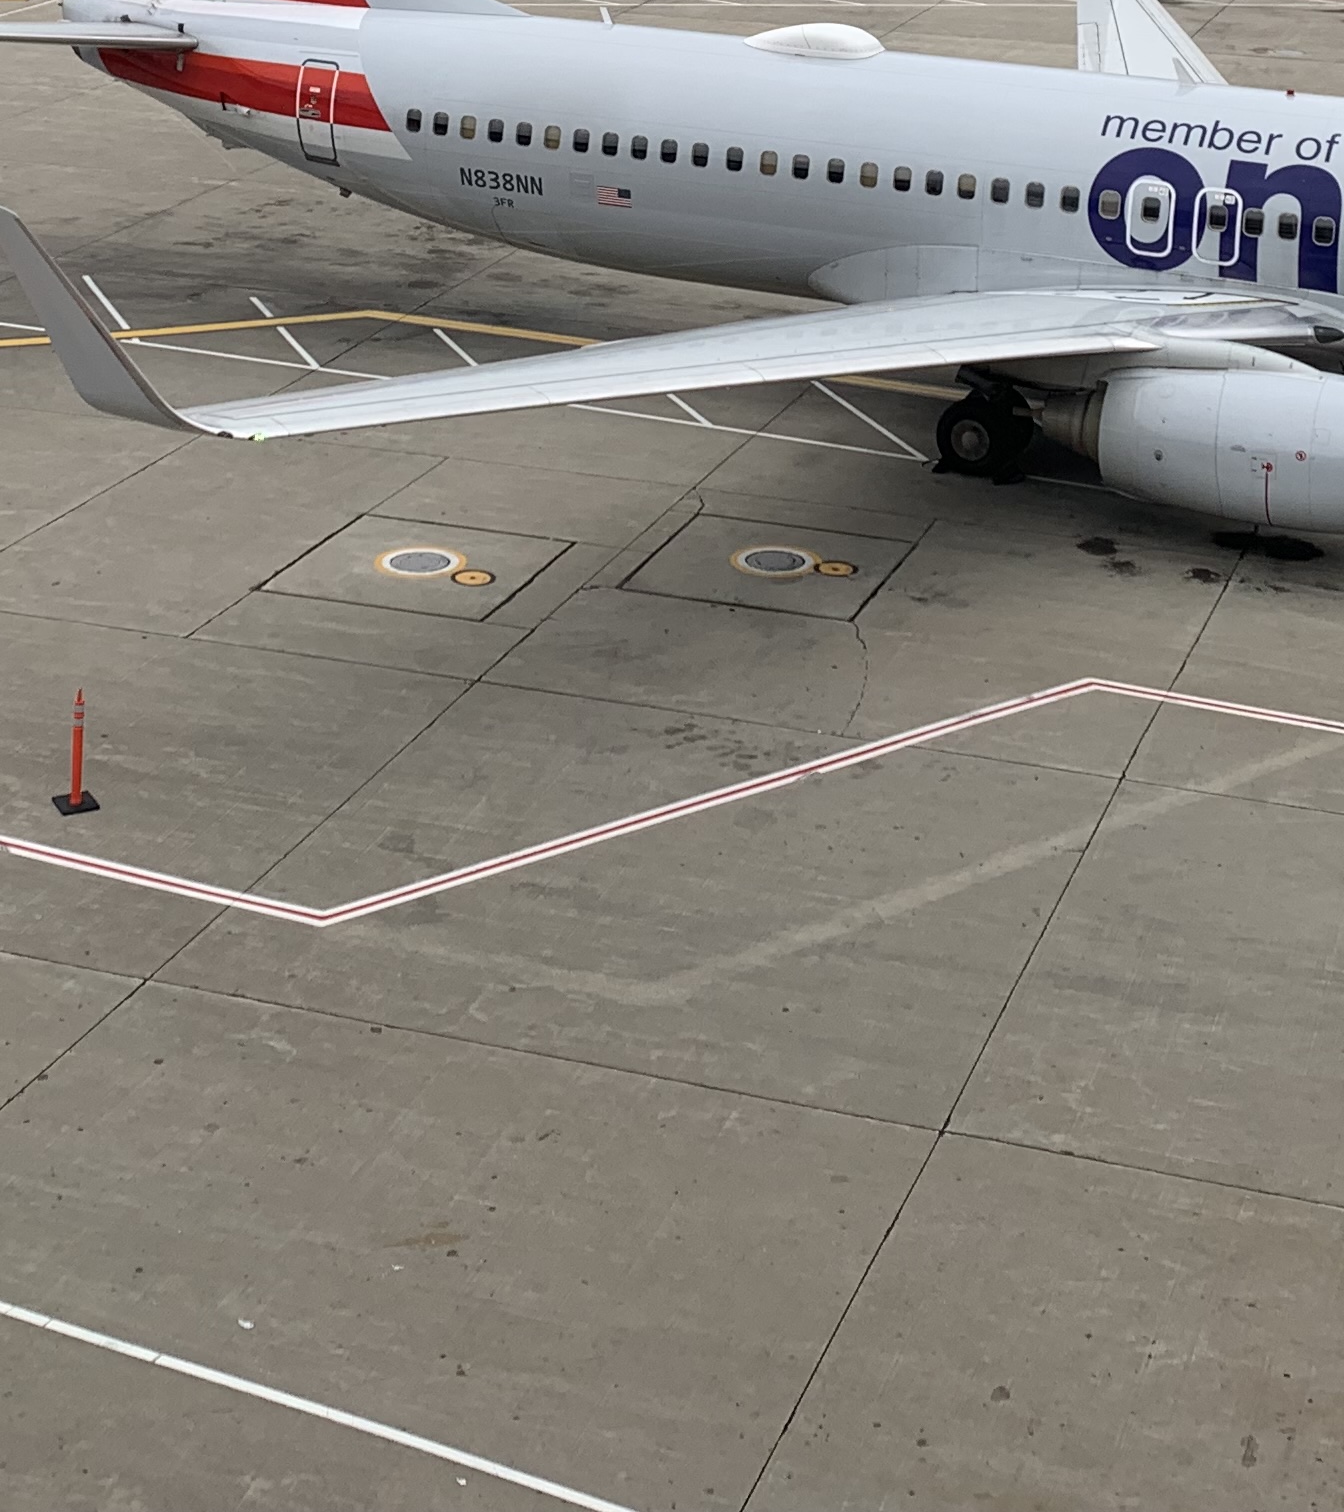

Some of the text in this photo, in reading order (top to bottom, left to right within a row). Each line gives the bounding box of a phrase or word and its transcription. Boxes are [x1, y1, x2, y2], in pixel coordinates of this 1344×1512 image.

[1100, 113, 1342, 163] member of
[460, 167, 544, 196] N838NN
[493, 196, 515, 208] 3FR
